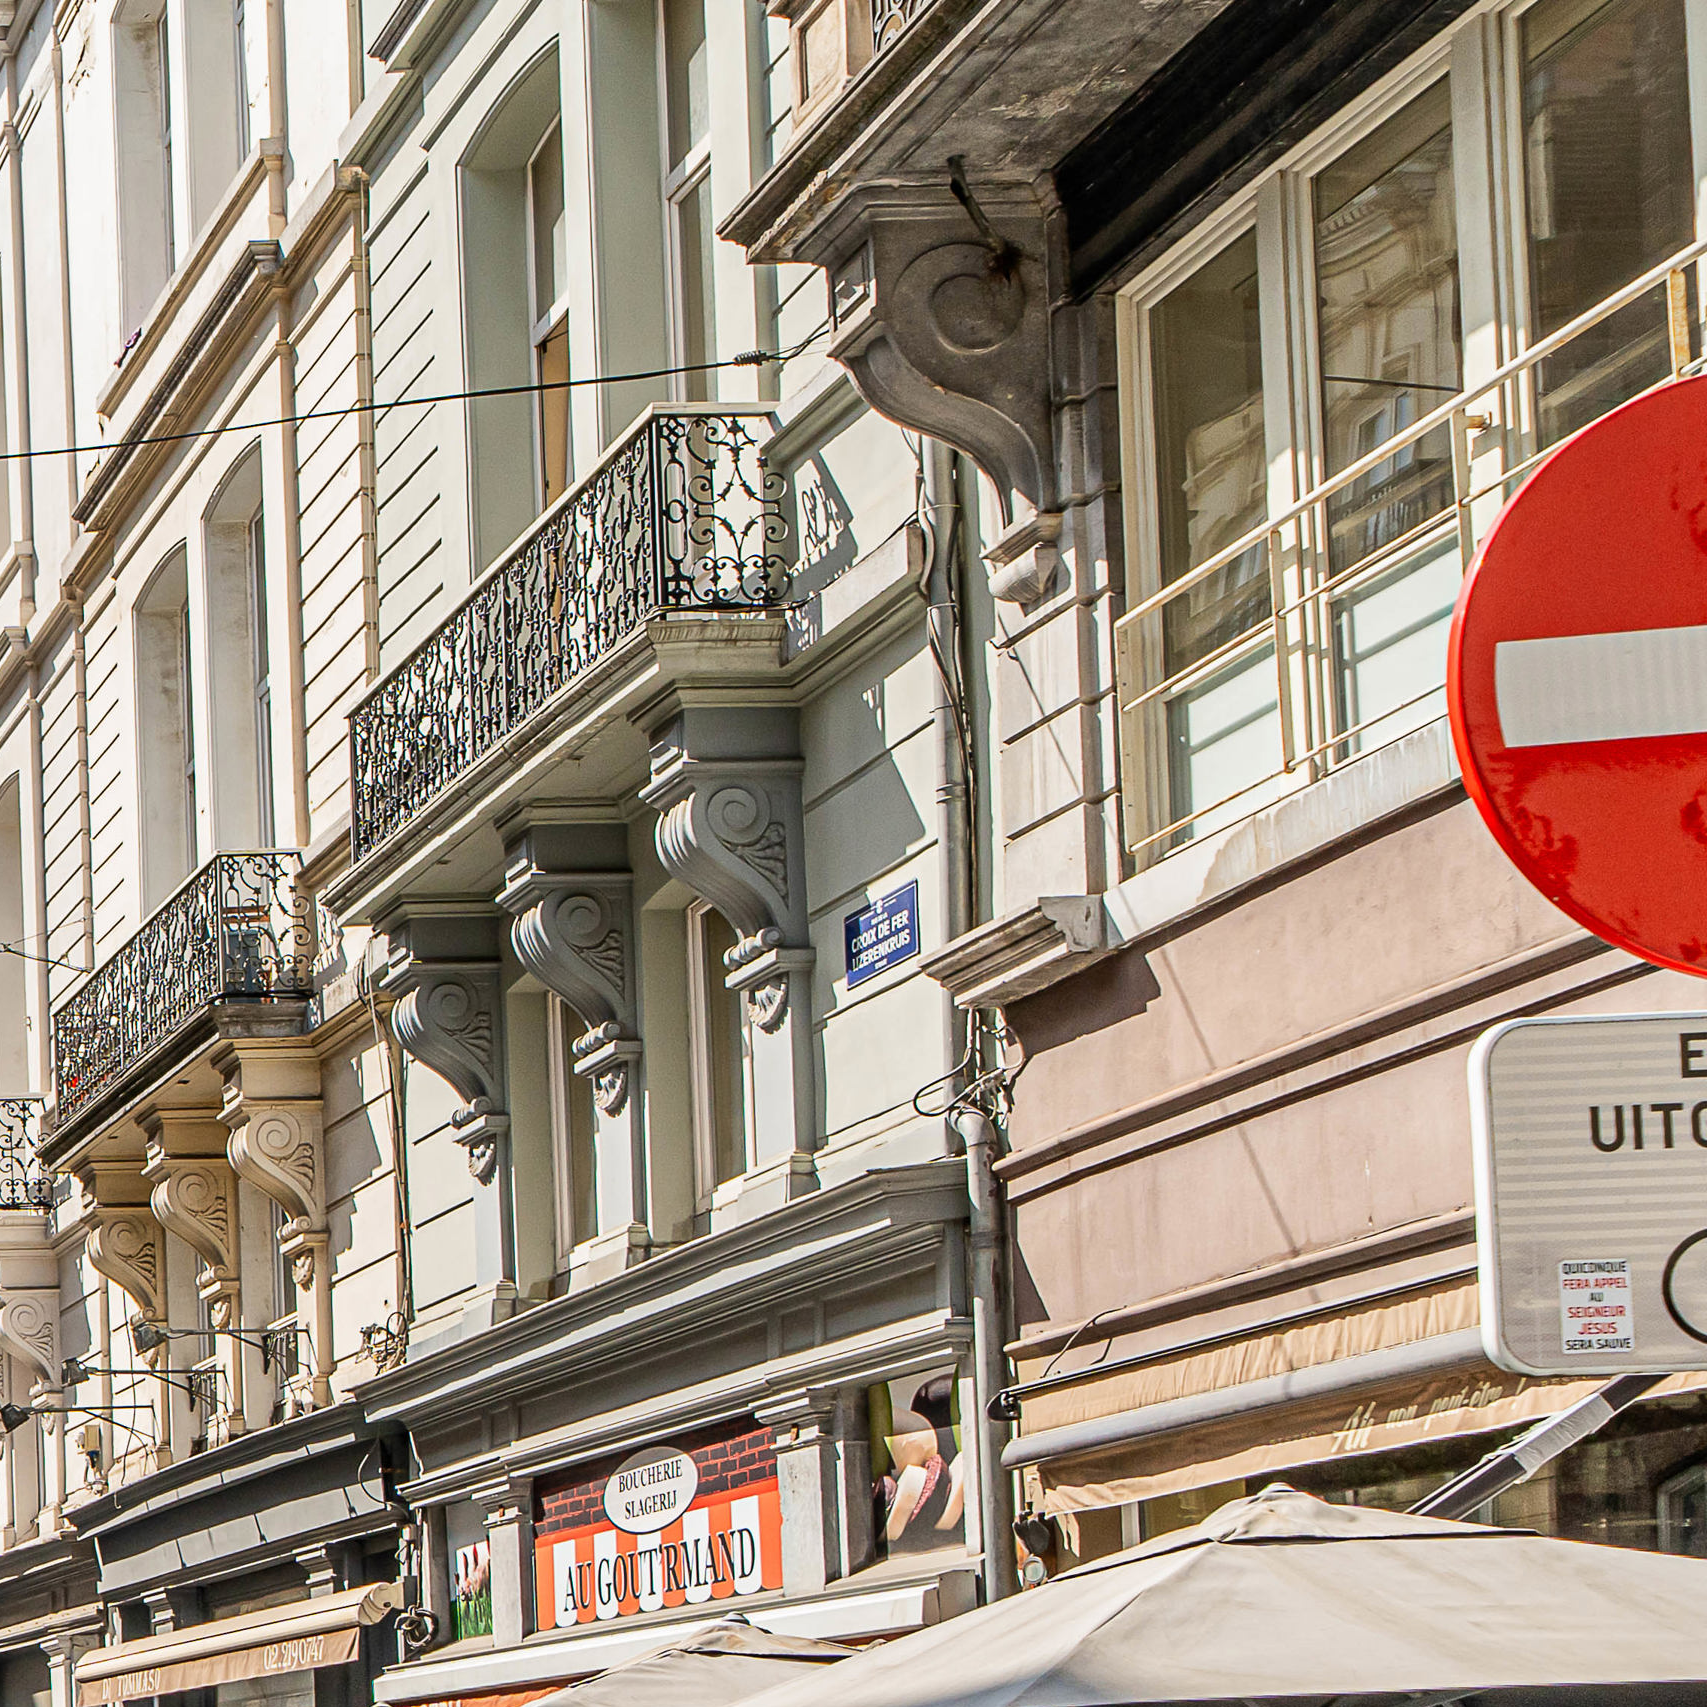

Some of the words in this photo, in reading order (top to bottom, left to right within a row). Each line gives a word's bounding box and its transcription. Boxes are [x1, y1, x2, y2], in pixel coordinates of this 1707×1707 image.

[851, 927, 877, 953] CROIX
[878, 920, 891, 940] DE
[891, 909, 909, 932] FER
[1563, 1278, 1591, 1290] FERA
[1594, 1277, 1627, 1289] APPEL
[1589, 1292, 1604, 1302] AU
[1567, 1305, 1626, 1318] SEIGNEUR
[1565, 1339, 1594, 1351] SERA
[618, 1458, 683, 1493] BOUCHERIE
[624, 1489, 678, 1520] SLAGERIJ
[563, 1561, 592, 1612] AU
[597, 1527, 756, 1606] GOUT'RMAND
